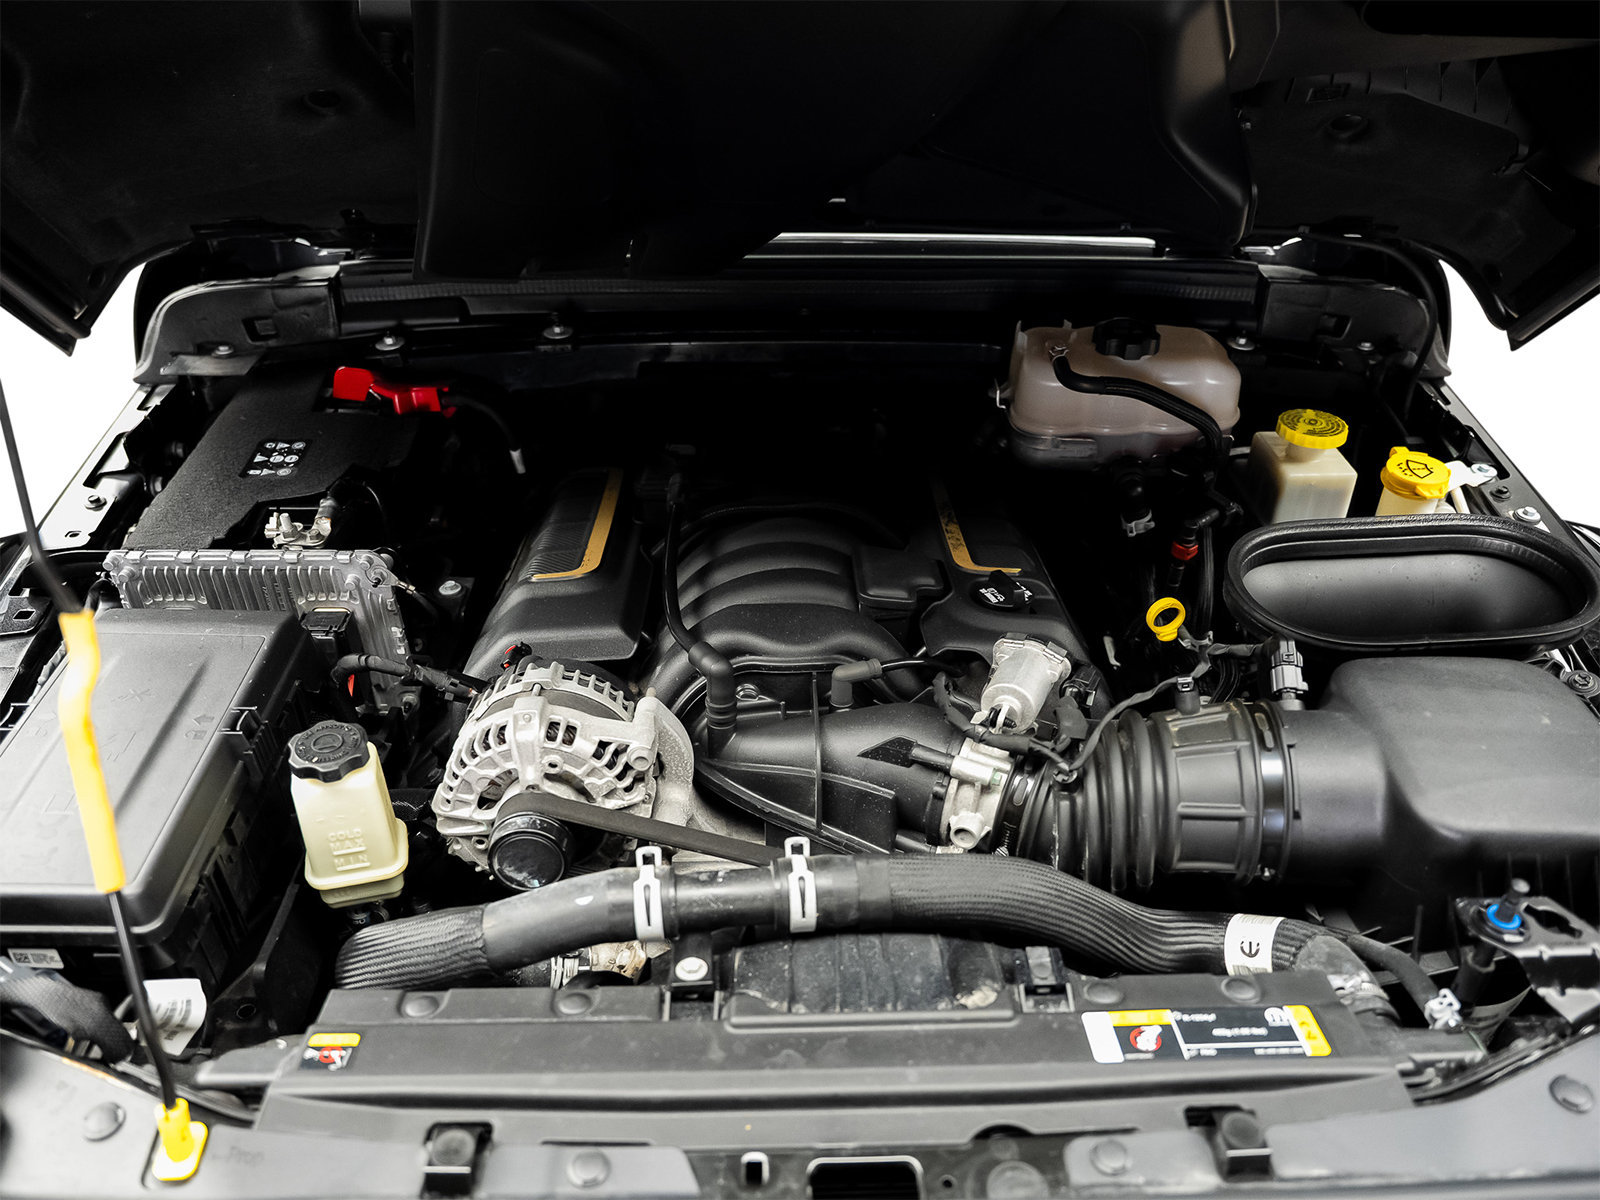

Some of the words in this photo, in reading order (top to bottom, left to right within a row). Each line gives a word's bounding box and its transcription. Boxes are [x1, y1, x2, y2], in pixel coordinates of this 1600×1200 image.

[328, 828, 362, 842] COLD
[329, 838, 366, 852] MAX
[333, 854, 368, 868] MIN
